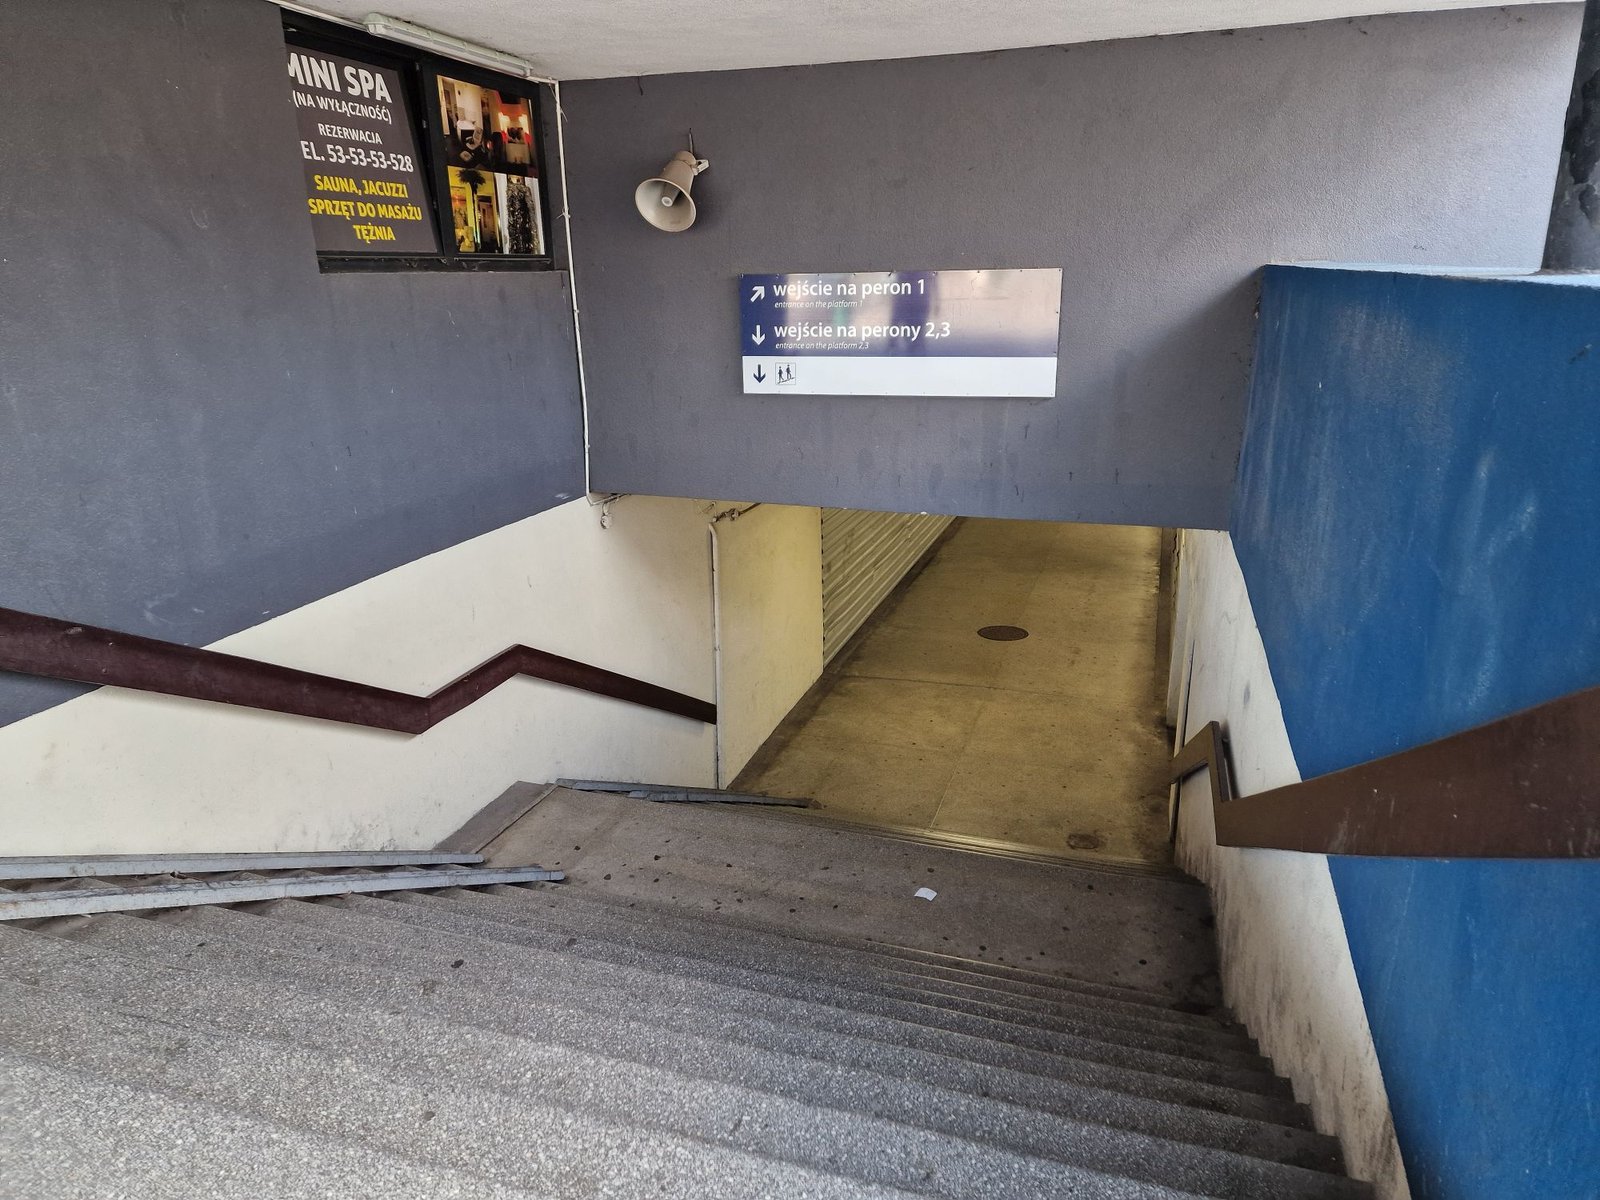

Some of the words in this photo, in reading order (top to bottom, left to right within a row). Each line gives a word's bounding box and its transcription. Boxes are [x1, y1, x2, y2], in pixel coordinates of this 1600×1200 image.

[288, 53, 341, 92] MINI
[344, 66, 392, 103] SPA
[293, 90, 316, 108] (NA
[316, 95, 392, 125] WYŁĄCZNOŚĆ)
[318, 123, 383, 145] REZERWACJA
[300, 140, 325, 161] EL.
[327, 144, 414, 173] 53-53-53-528
[314, 174, 362, 196] SAUNA,
[362, 179, 409, 198] JACUZZI
[308, 198, 355, 220] SPRZĘT
[357, 202, 377, 218] DO
[377, 203, 422, 221] MASAŻU
[353, 222, 396, 244] TĘŻNIA
[773, 280, 833, 301] wejście
[837, 283, 857, 296] na
[861, 282, 912, 300] peron
[917, 279, 925, 294] 1
[774, 301, 804, 309] entrance
[815, 300, 827, 308] the
[827, 300, 858, 310] platform
[774, 322, 833, 341] wejście
[837, 325, 857, 338] na
[861, 324, 922, 342] perony
[925, 322, 951, 340] 2,3
[775, 342, 804, 350] entrance
[815, 341, 827, 350] the
[827, 341, 858, 351] platform
[858, 341, 870, 350] 2,3
